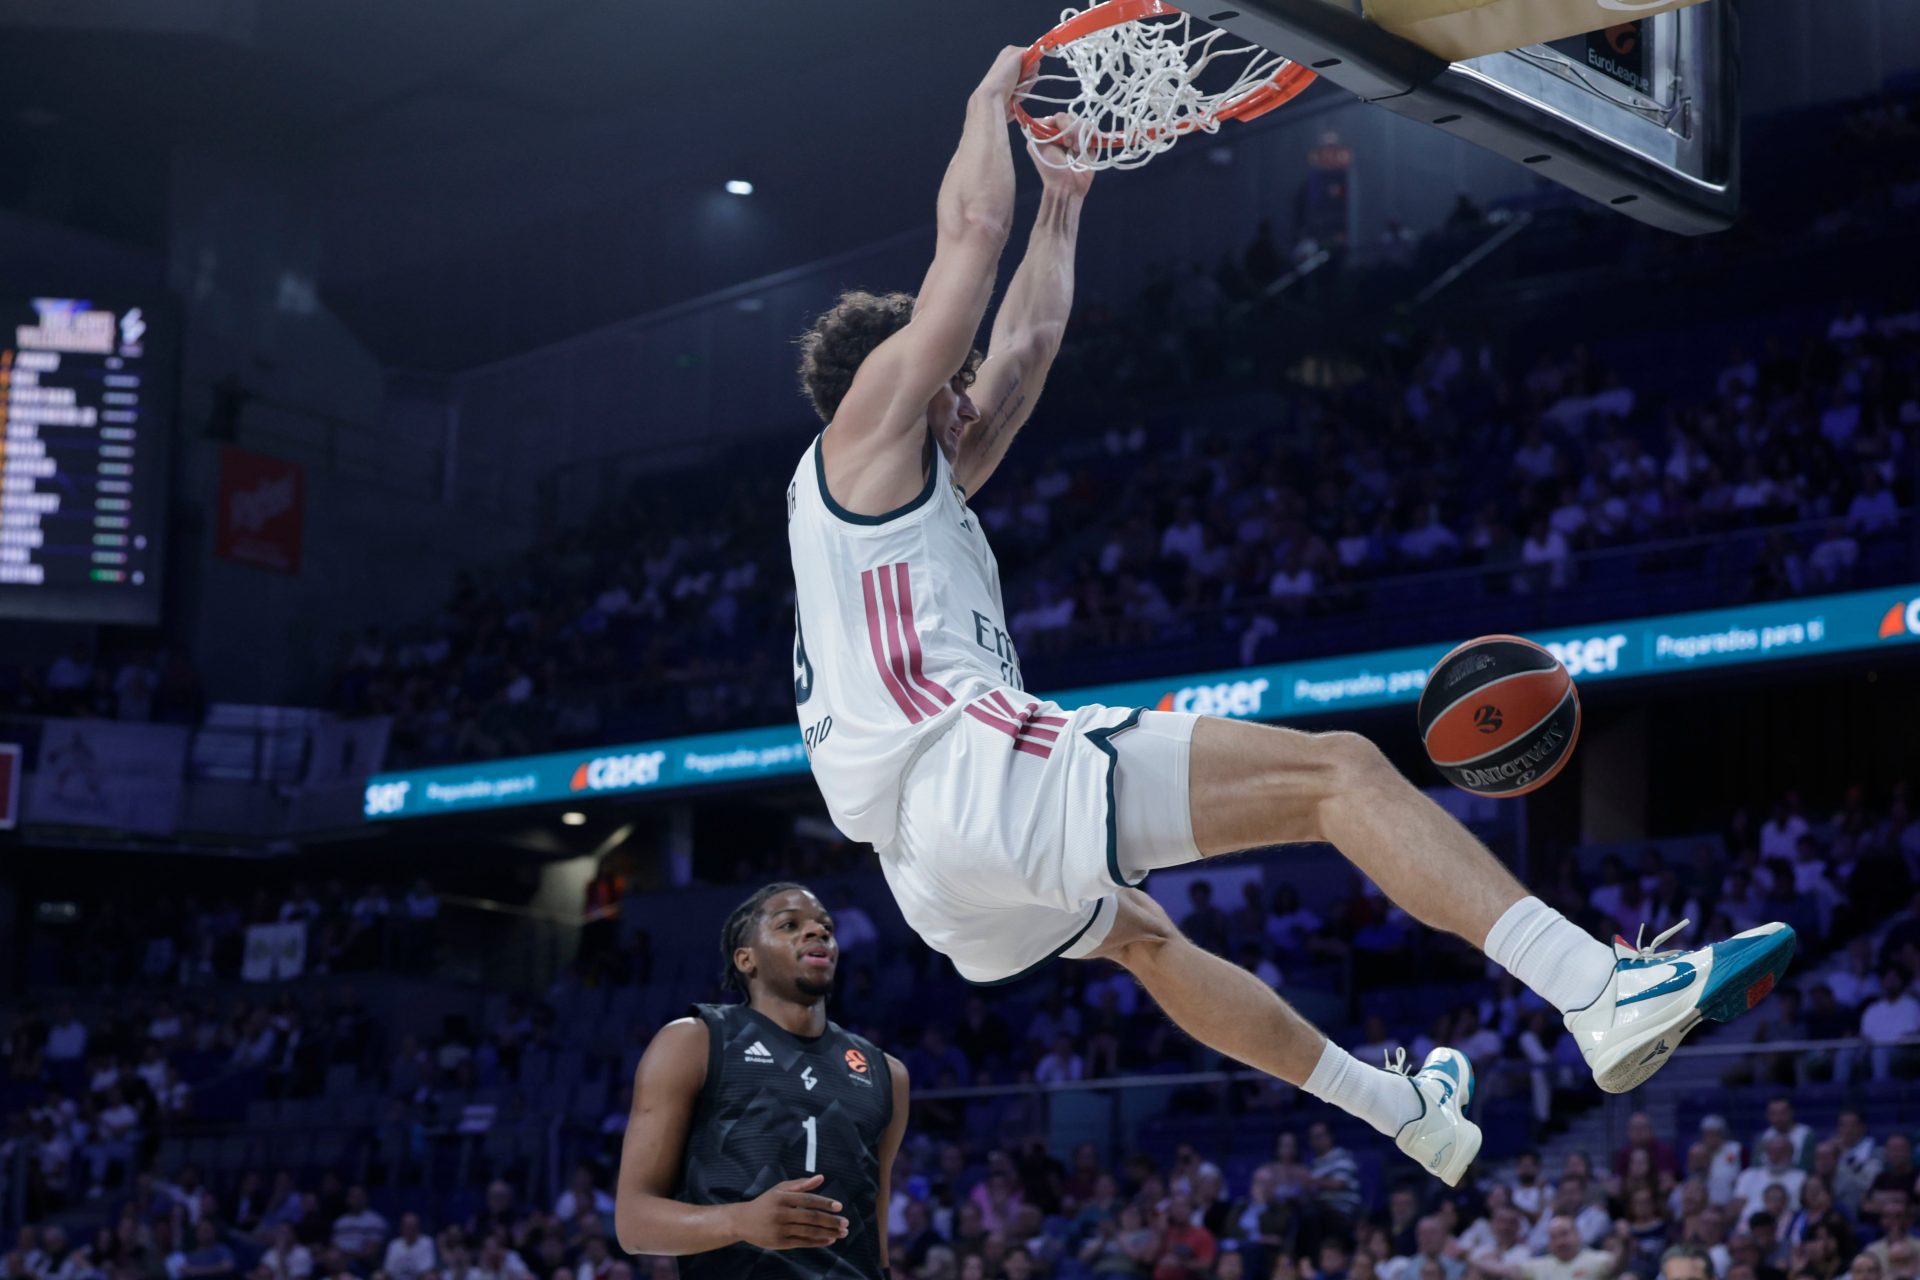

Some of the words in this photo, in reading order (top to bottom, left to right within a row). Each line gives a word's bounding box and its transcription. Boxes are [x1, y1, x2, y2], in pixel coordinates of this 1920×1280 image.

[1587, 47, 1650, 91] EuroLeague
[1656, 624, 1758, 662] Preparados
[1761, 622, 1804, 653] para
[1173, 678, 1269, 717] caser
[1295, 668, 1385, 704] Preparados
[587, 750, 667, 790] caser
[1460, 721, 1565, 787] SPALDING
[802, 1115, 817, 1173] 1
